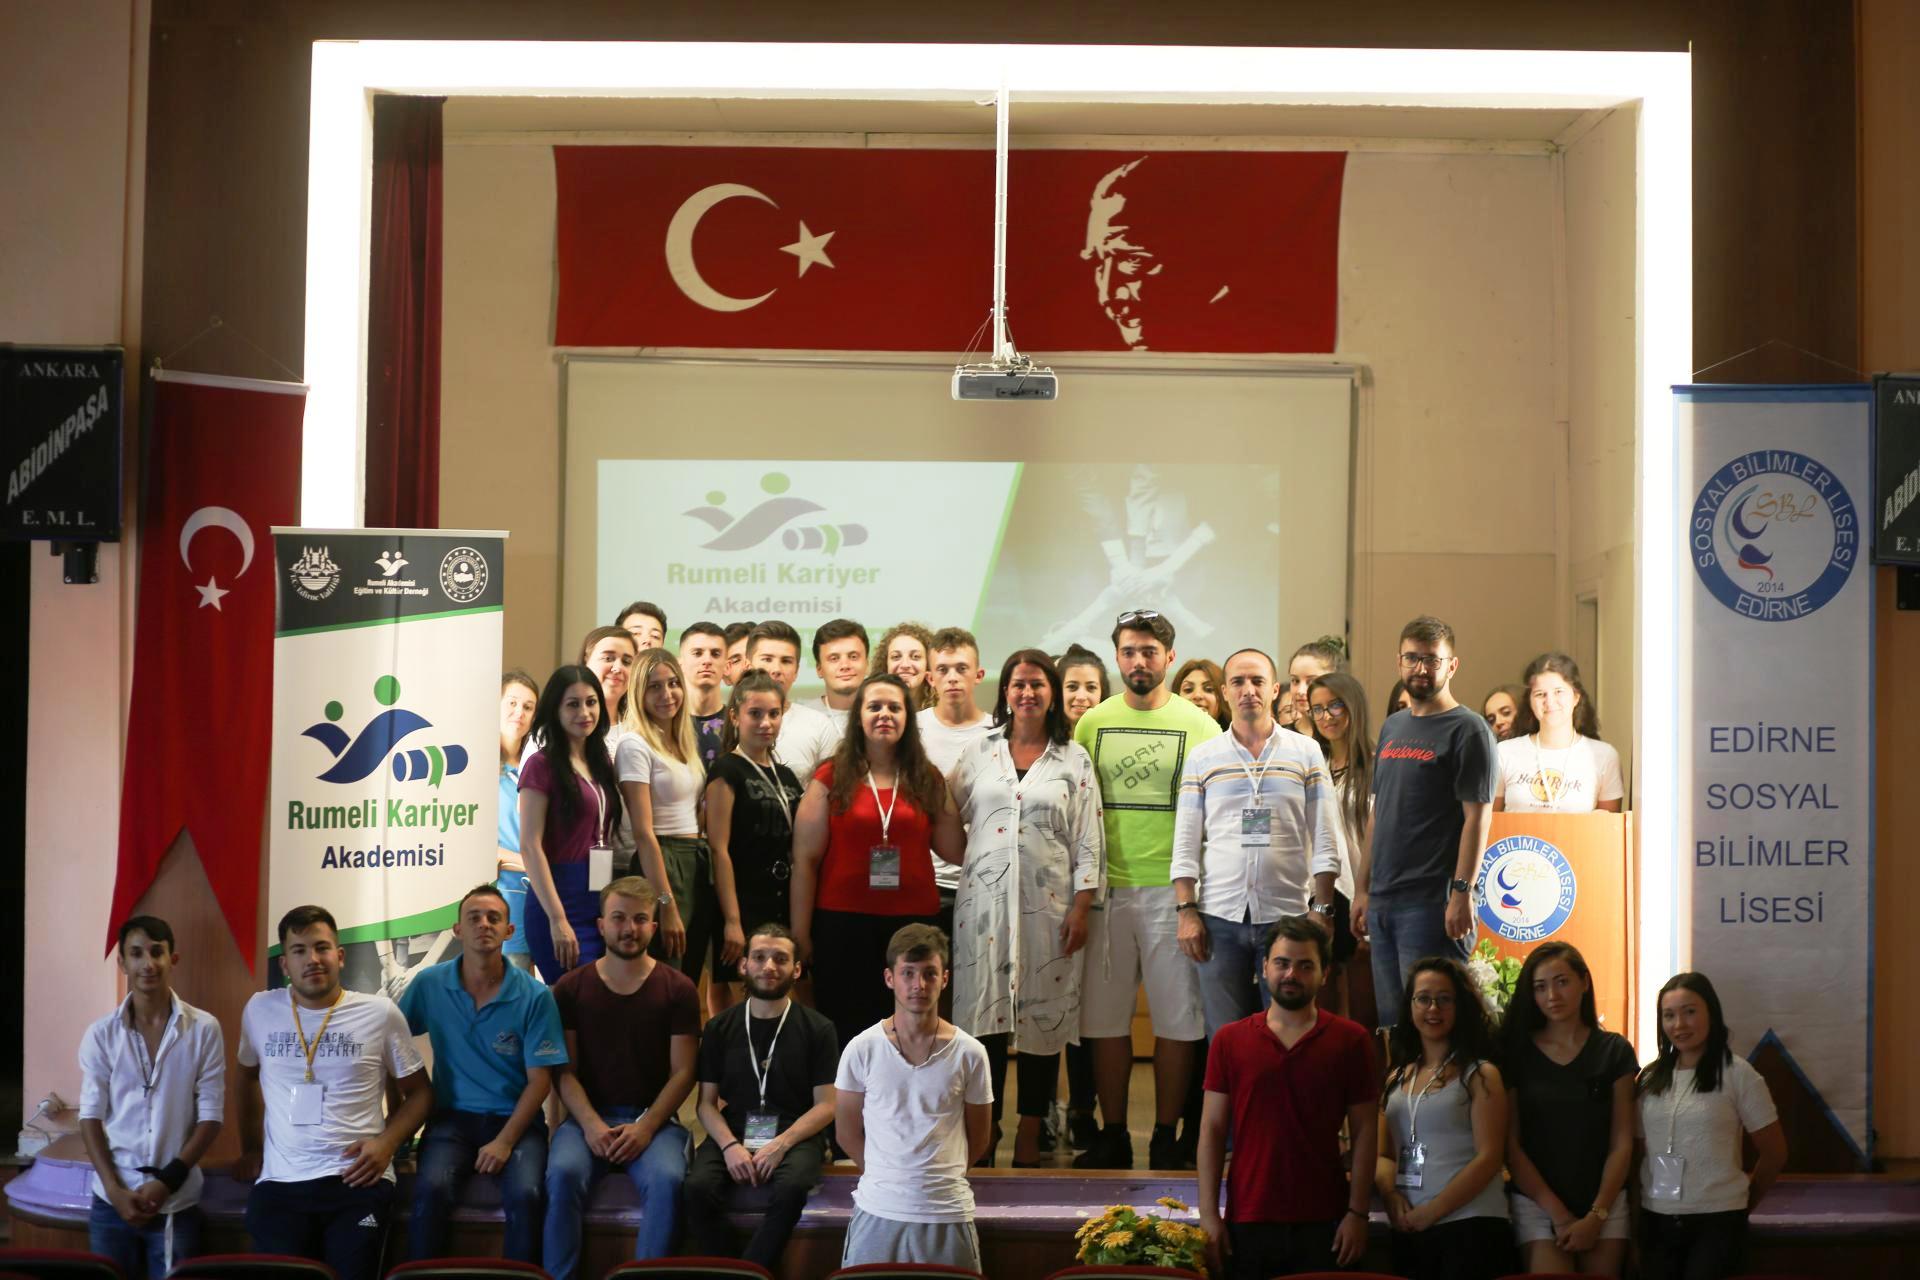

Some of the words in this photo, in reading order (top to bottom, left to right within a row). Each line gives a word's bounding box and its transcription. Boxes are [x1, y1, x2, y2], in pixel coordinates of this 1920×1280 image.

[20, 362, 100, 378] ANKARA
[1695, 479, 1733, 568] SOSYAL
[1731, 451, 1831, 493] BİLİMLER
[667, 563, 767, 585] Rumeli
[777, 563, 880, 588] Kariyer
[1757, 582, 1784, 593] 2014
[704, 597, 843, 614] Akademisi
[1735, 593, 1812, 619] EDİRNE
[1710, 722, 1836, 753] EDİRNE
[1124, 759, 1160, 789] OUT
[1551, 775, 1583, 793] Rck
[1706, 783, 1839, 810] SOSYAL
[288, 799, 377, 830] Rumeli
[387, 798, 479, 833] Kariyer
[321, 843, 444, 869] Akademisi
[1696, 835, 1849, 867] BİLİMLER
[1720, 891, 1823, 923] LİSESİ
[264, 1043, 307, 1058] SURFE
